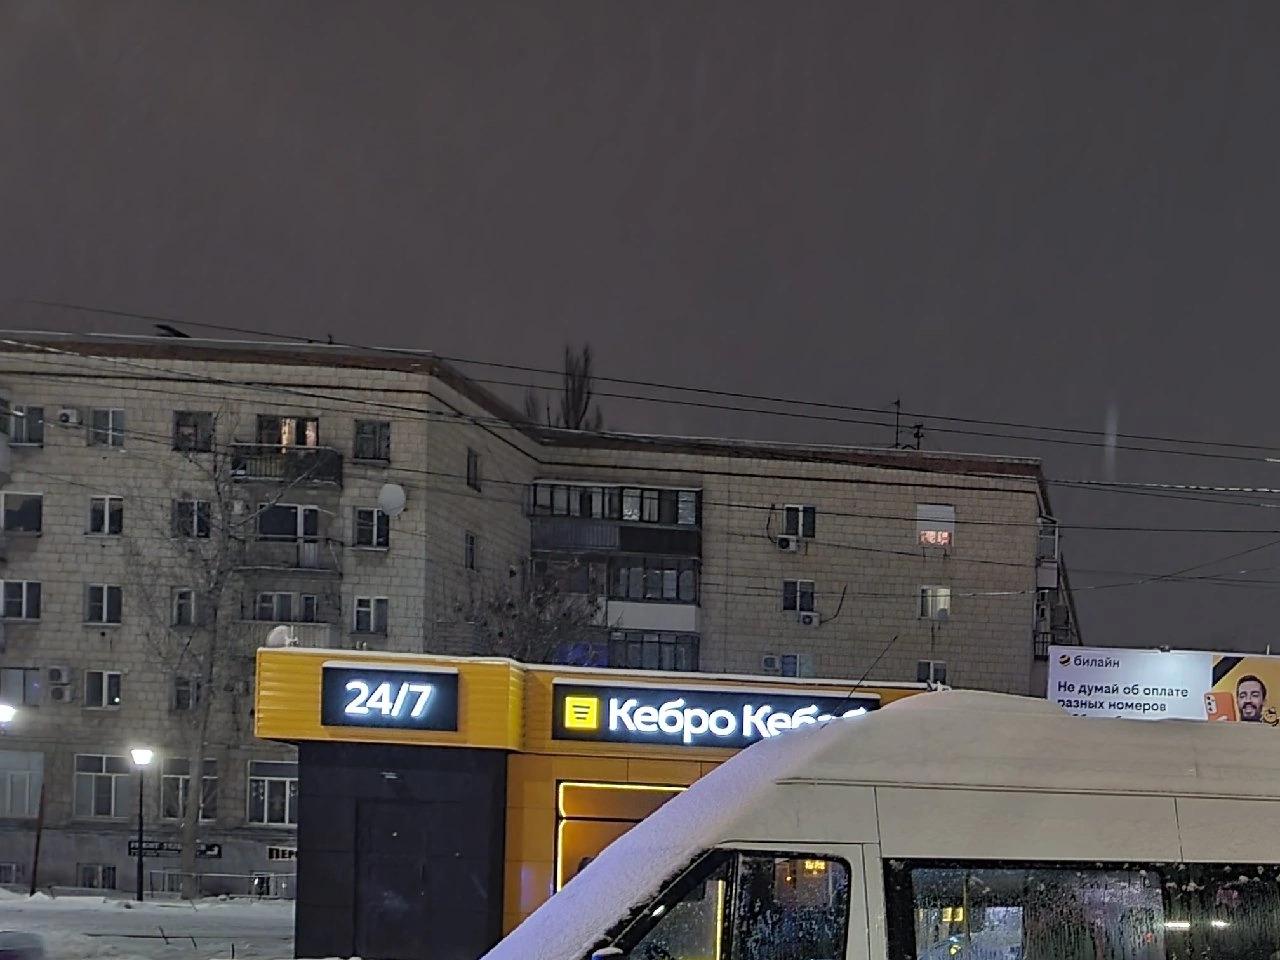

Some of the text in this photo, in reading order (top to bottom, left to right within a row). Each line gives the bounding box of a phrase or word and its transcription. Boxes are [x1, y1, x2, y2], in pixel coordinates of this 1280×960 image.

[1074, 655, 1120, 668] билайн
[1058, 681, 1189, 698] Не думай об оплате
[345, 681, 432, 717] 24/7
[1108, 701, 1167, 714] номеров
[609, 697, 867, 743] Кебро Кеб
